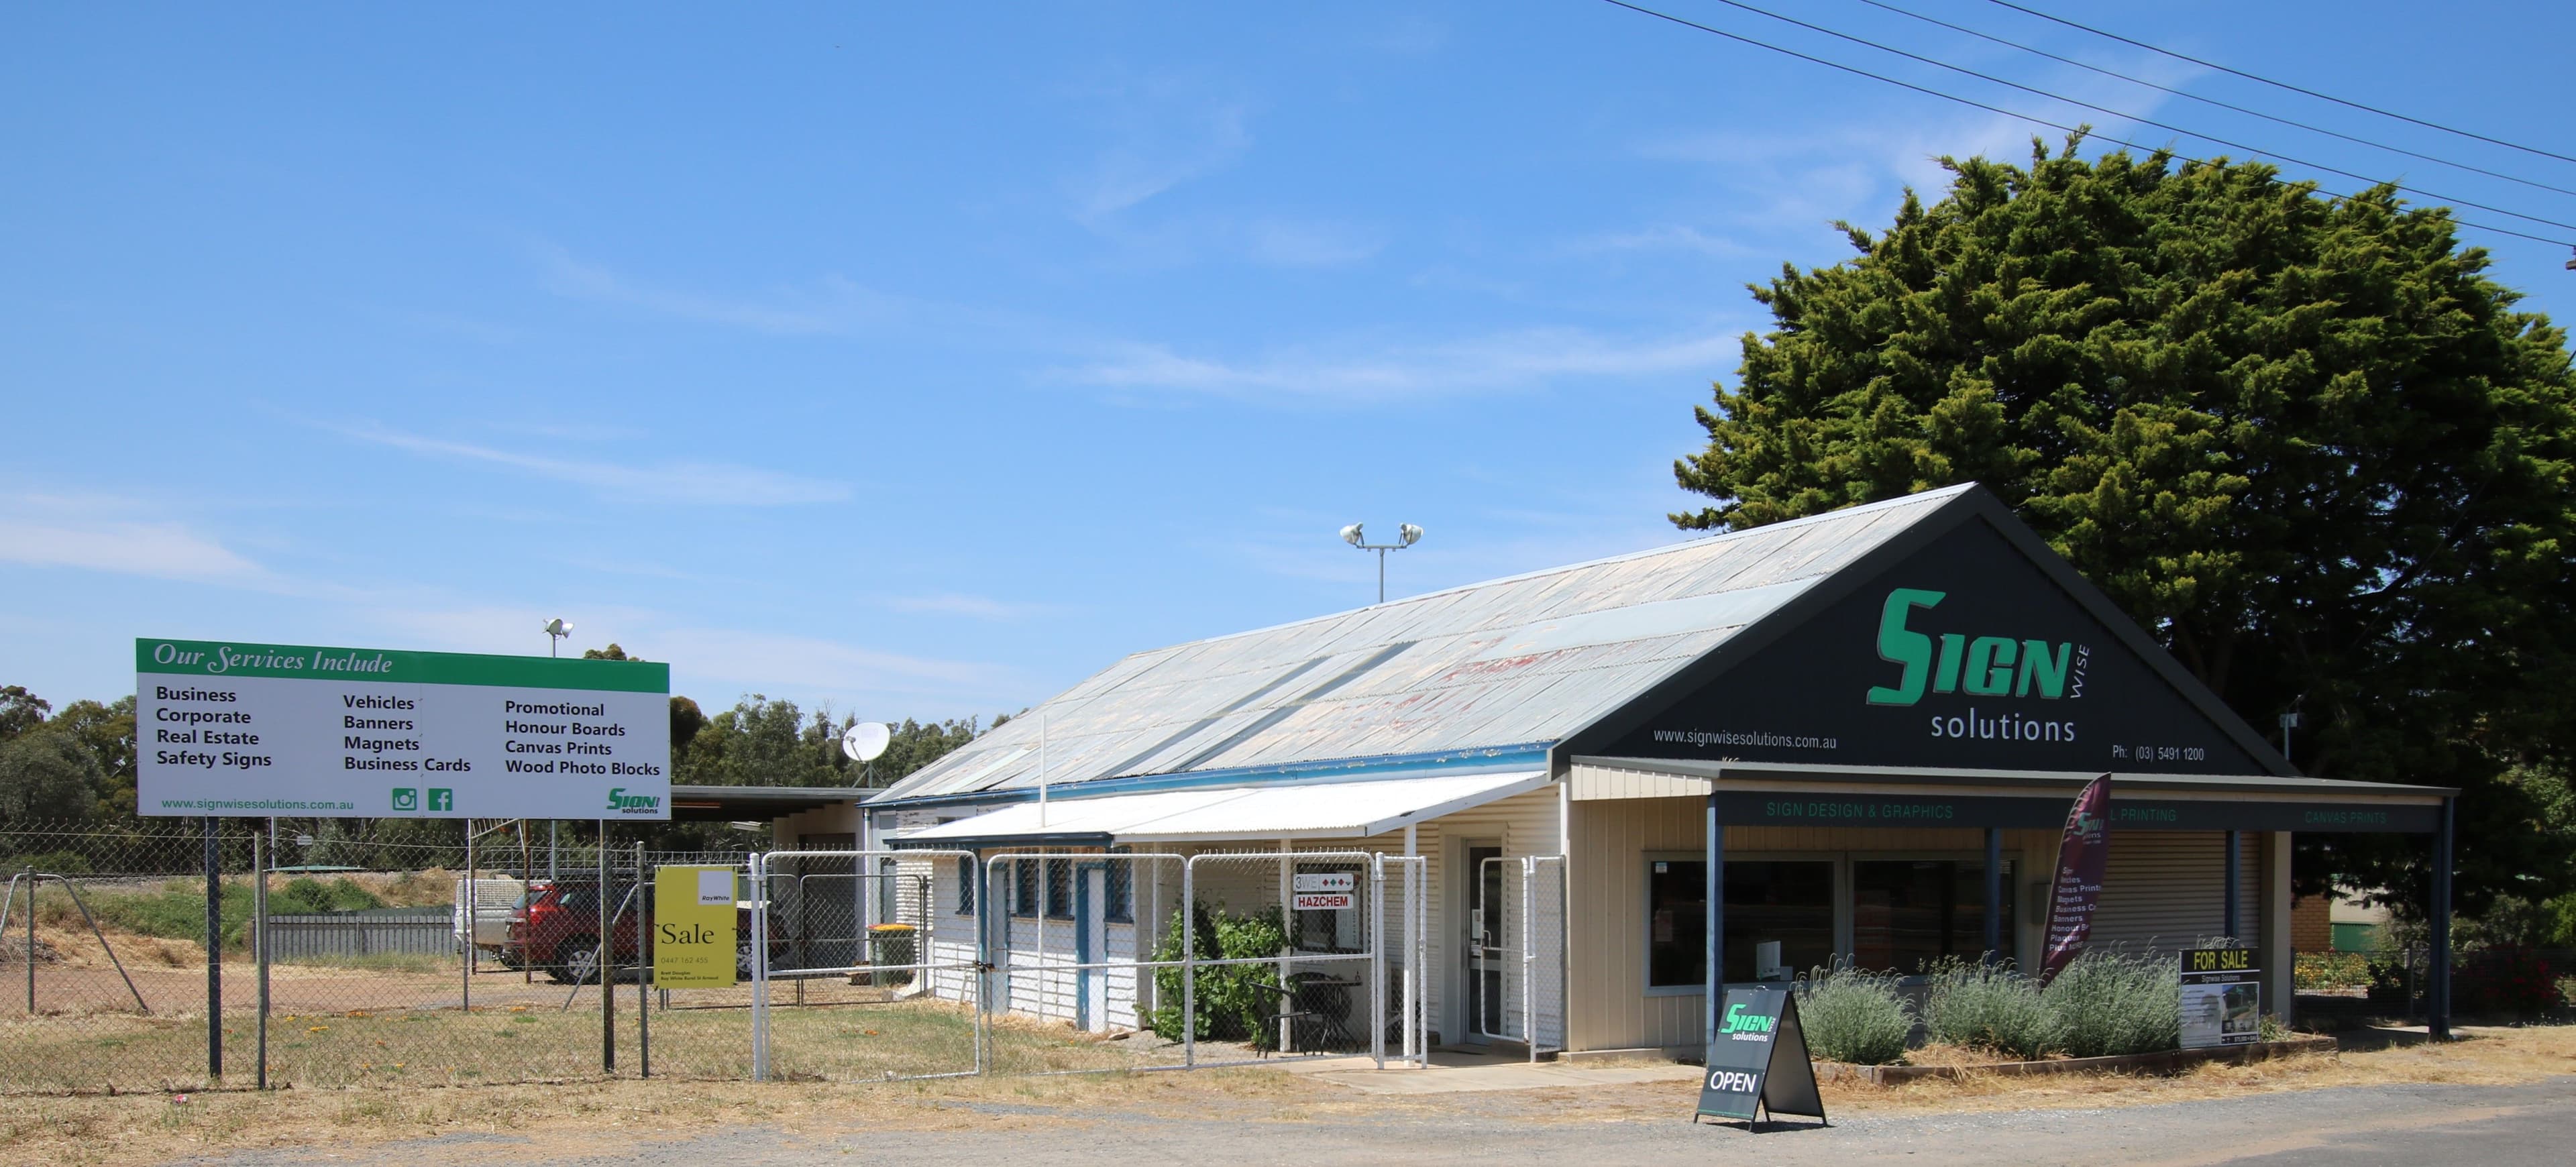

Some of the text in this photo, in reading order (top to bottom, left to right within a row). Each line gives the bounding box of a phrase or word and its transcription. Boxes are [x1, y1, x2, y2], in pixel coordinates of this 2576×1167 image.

[1866, 588, 2072, 706] SIGN
[154, 643, 392, 673] Our Services Include
[2070, 645, 2090, 698] WISE
[156, 686, 236, 702] Business
[343, 695, 415, 710] Vehicles
[505, 700, 604, 716] Promotional
[156, 708, 252, 726] Corporate
[344, 716, 413, 730] Banners
[1931, 708, 2074, 742] solutions
[505, 720, 625, 736] Honour Boards
[156, 729, 260, 745] Real Estate
[344, 736, 419, 753] Magnets
[1654, 728, 1837, 749] www.signwisesolutions.com.au
[505, 740, 612, 755] Canvas Prints
[2113, 745, 2204, 762] Ph: (03) 5491 1200
[156, 751, 272, 769] Safety Signs
[344, 757, 471, 771] Business Cards
[505, 760, 660, 776] Wood Photo Blocks
[162, 799, 354, 811] www.signwisesolutions.com.au
[622, 806, 658, 814] solutions
[1766, 802, 1953, 819] SIGN DESIGN & GRAPHICS
[2121, 808, 2177, 822] PRINTING
[2305, 811, 2387, 824] CANVAS PRINTS
[1295, 876, 1317, 889] 3WE
[1298, 896, 1348, 907] HAZCHEM
[661, 923, 714, 944] Sale
[2194, 950, 2248, 970] FOR SALE
[1721, 1003, 1772, 1033] SIGN
[1732, 1031, 1768, 1042] solutions
[1710, 1071, 1757, 1093] OPEN
